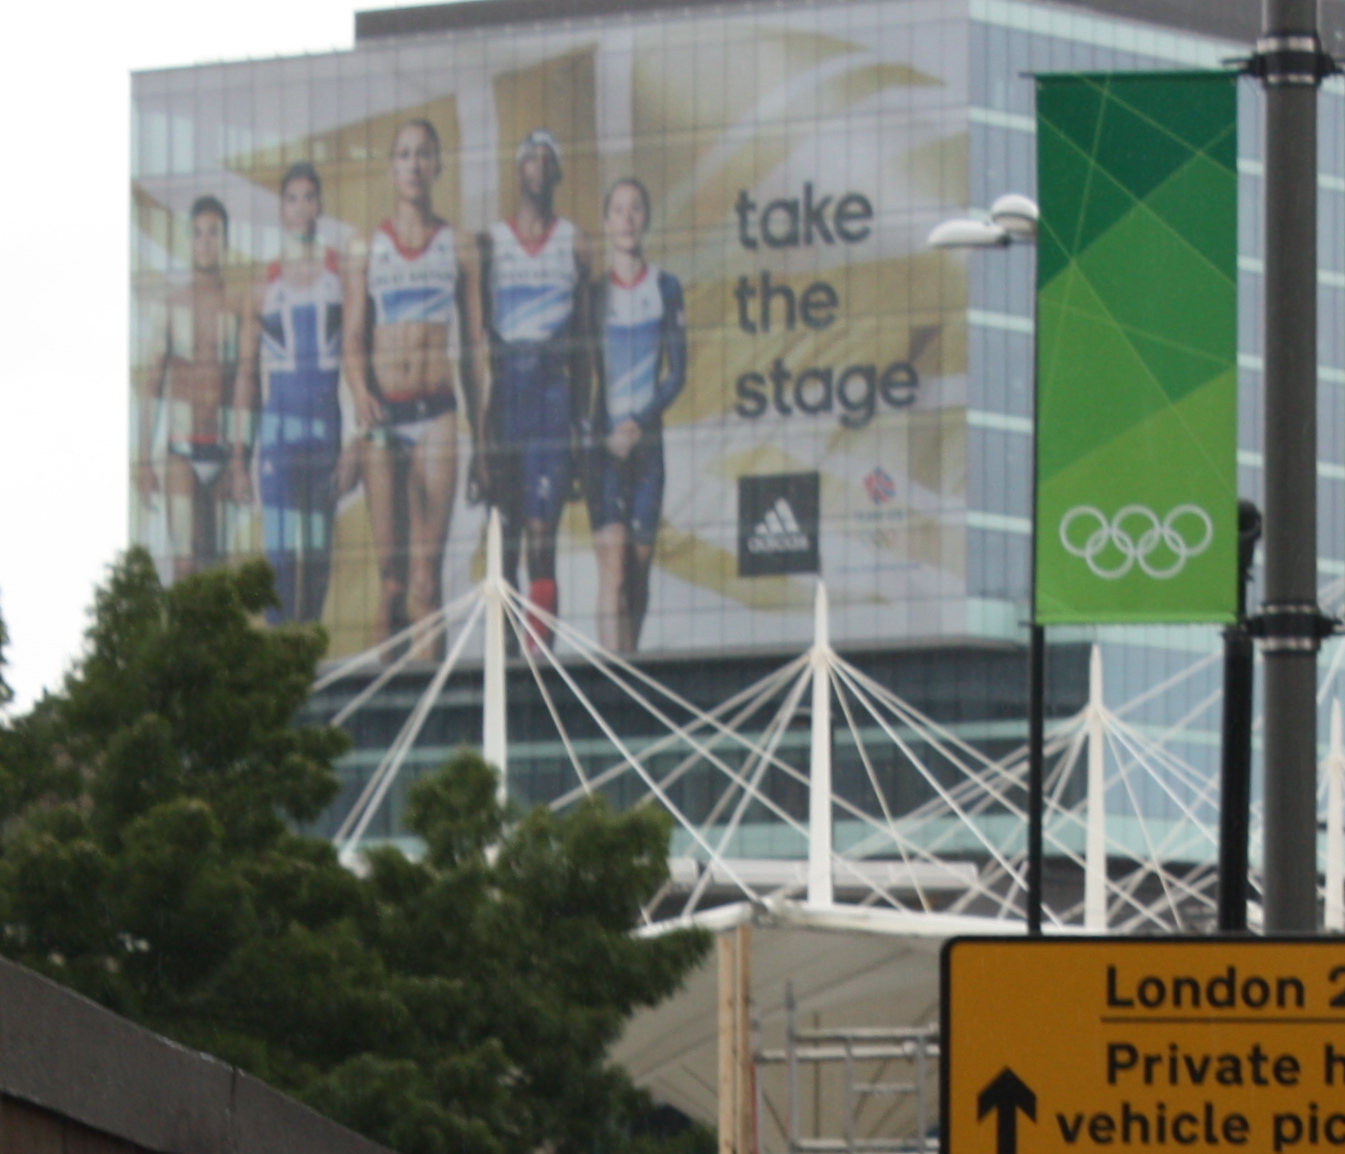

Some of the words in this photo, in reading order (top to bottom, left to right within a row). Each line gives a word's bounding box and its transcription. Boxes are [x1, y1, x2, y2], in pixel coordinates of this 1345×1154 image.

[735, 181, 874, 250] take
[734, 270, 839, 335] the
[734, 357, 919, 429] stage
[1106, 965, 1305, 1009] London
[1107, 1043, 1301, 1087] Private
[1056, 1102, 1250, 1146] vehicle
